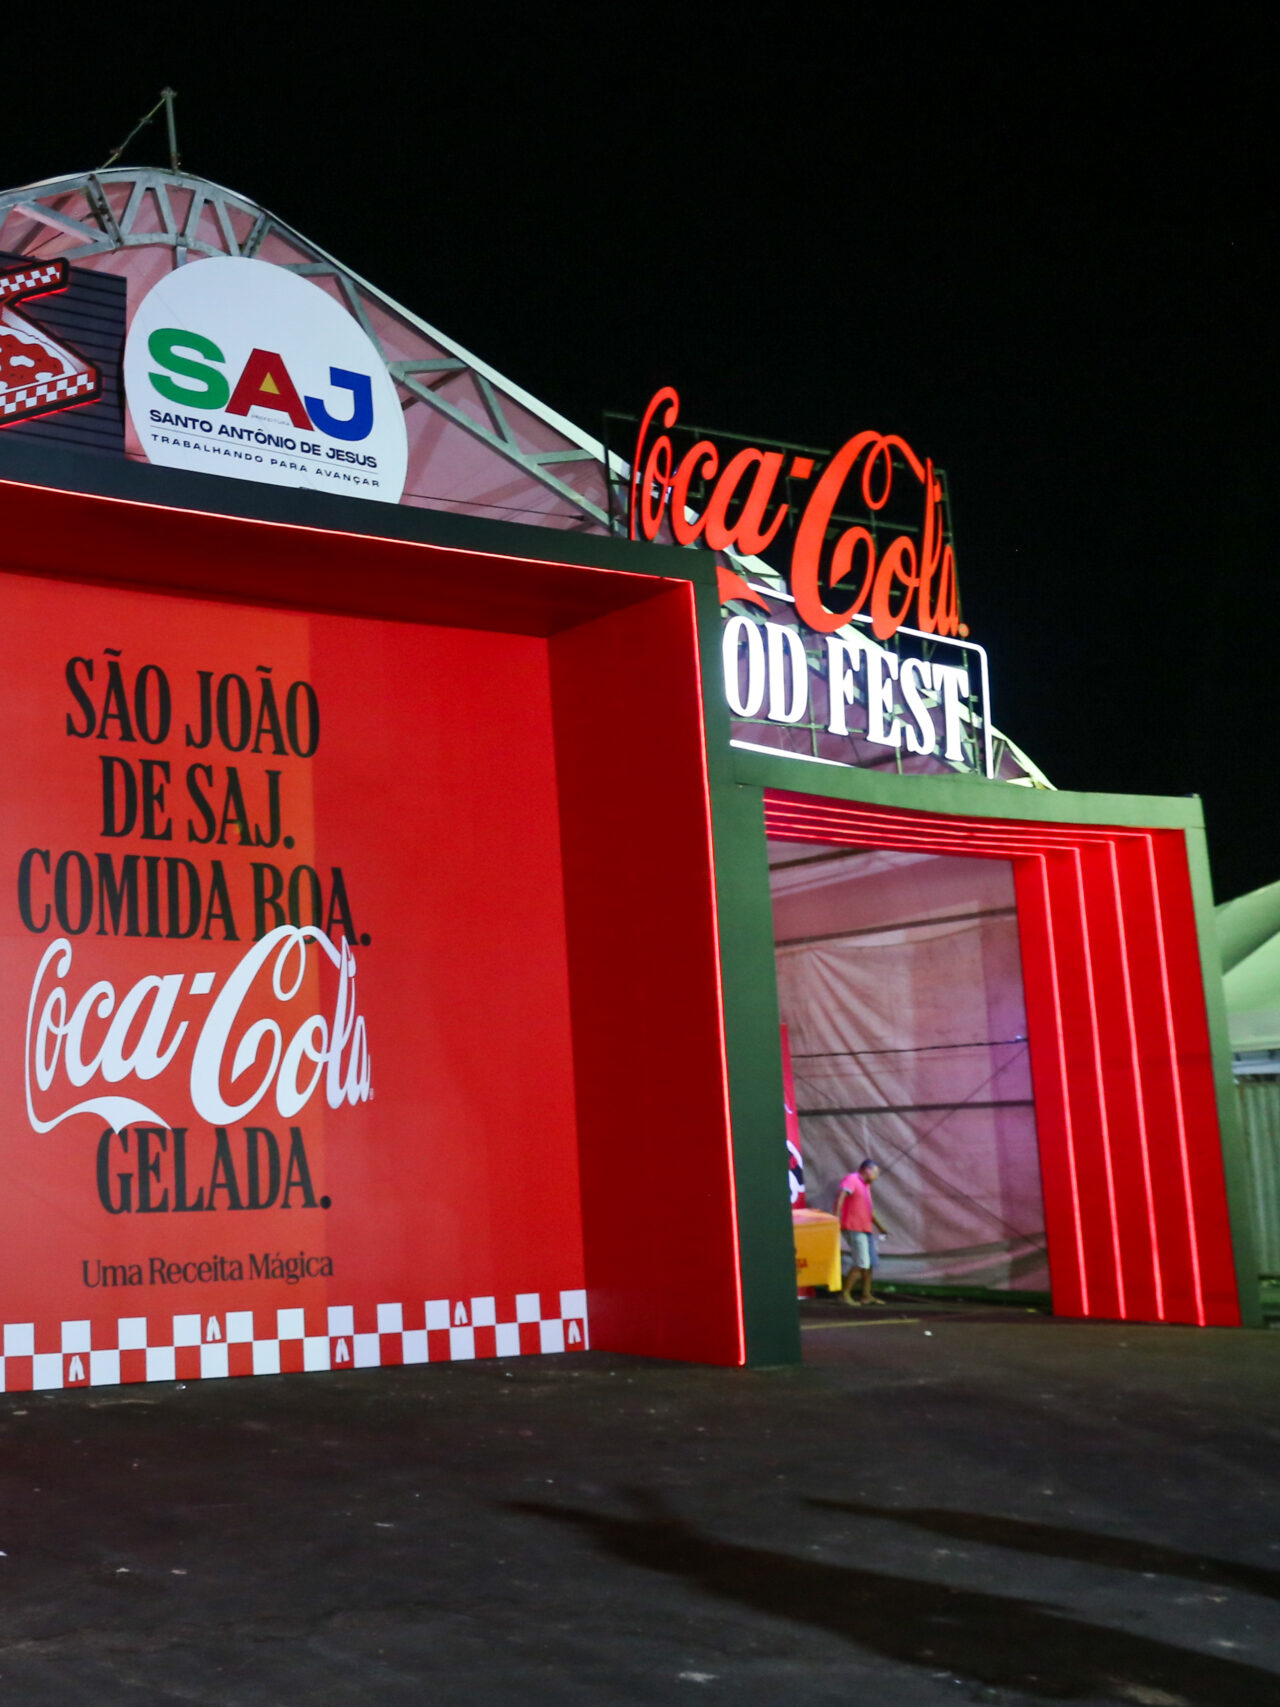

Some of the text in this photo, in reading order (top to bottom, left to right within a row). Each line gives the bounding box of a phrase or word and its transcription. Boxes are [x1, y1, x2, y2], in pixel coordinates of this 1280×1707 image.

[148, 327, 374, 442] SAJ
[149, 409, 378, 469] SANTO ANTÔNIO DE JESUS
[151, 434, 380, 488] TRABALHANDO PARA AVANÇAR
[630, 386, 963, 641] Coca-Cola
[65, 648, 321, 759] SÃO JOÃO
[826, 637, 970, 763] FEST
[99, 755, 295, 850] DE SAJ.
[17, 847, 373, 947] COMIDA BOA.
[24, 924, 372, 1135] Coca-Cola
[95, 1126, 333, 1215] GELADA.
[82, 1251, 334, 1289] Uma Receita Mágica
